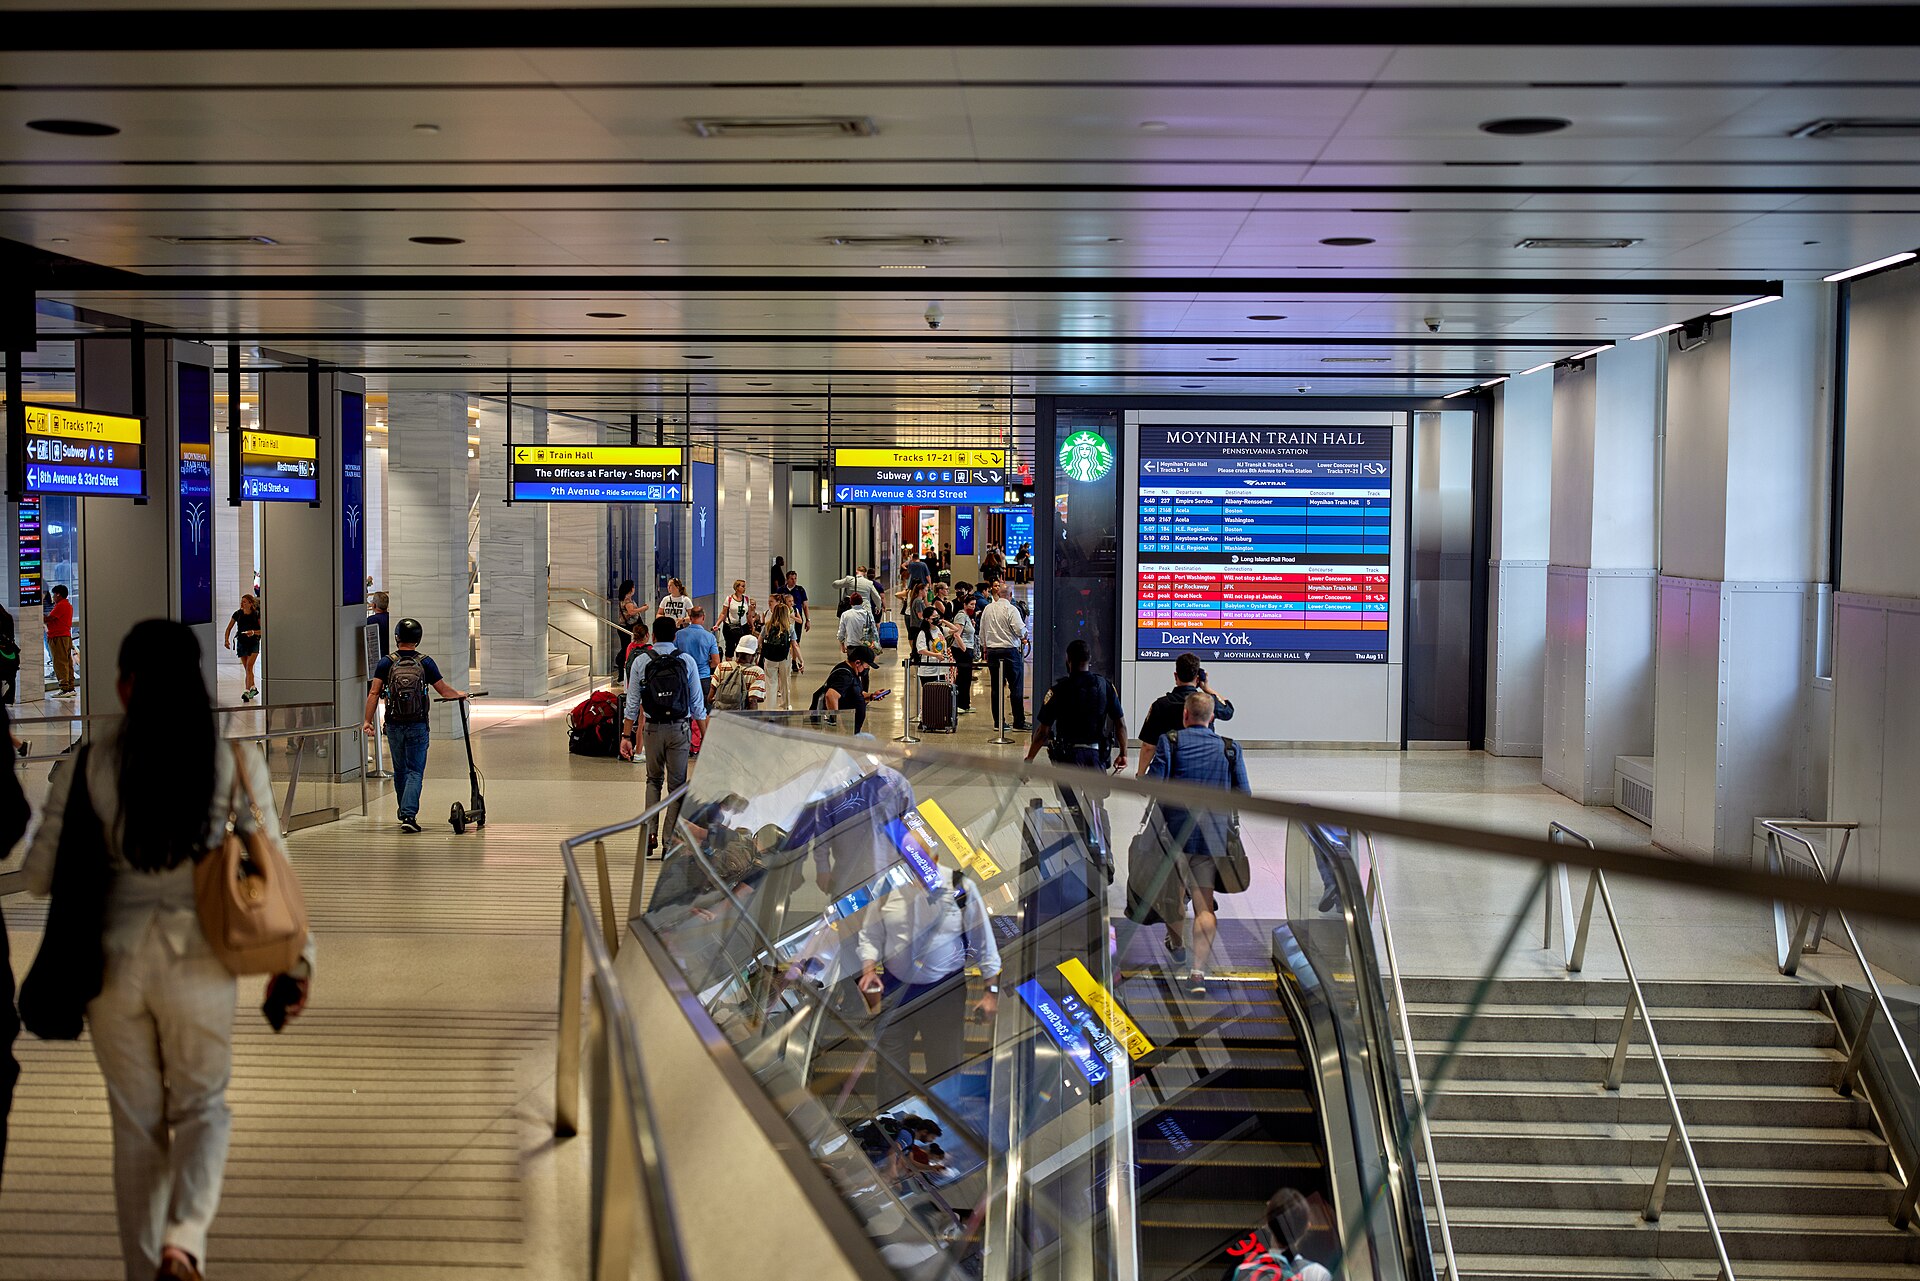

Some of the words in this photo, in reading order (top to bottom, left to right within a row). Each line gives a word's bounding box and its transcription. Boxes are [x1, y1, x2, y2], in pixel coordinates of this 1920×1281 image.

[62, 418, 84, 432] Tracks
[85, 421, 104, 434] 17-21
[258, 437, 270, 448] Train
[270, 438, 278, 449] Hall
[1166, 431, 1261, 444] MOYNIHAN
[1266, 432, 1318, 445] TRAIN
[1322, 432, 1365, 445] HALL
[62, 444, 88, 461] Subway
[550, 450, 573, 459] Train
[575, 451, 594, 459] Hall
[893, 453, 924, 462] Tracks
[927, 453, 953, 462] 17-21
[277, 462, 299, 473] Restrooms
[40, 471, 52, 484] 8th
[52, 472, 77, 485] Avenue
[78, 473, 84, 485] &
[84, 473, 98, 486] 33rd
[99, 474, 118, 487] Street
[535, 468, 552, 477] The
[554, 468, 585, 478] Offices
[586, 469, 596, 478] at
[599, 469, 627, 480] Farley
[634, 470, 662, 480] Shops
[876, 472, 912, 482] Subway
[258, 482, 268, 492] 31st
[268, 482, 282, 493] Street
[550, 486, 565, 496] 9th
[568, 487, 600, 496] Avenue
[854, 489, 869, 498] 8th
[871, 489, 904, 498] Avenue
[907, 490, 914, 498] &
[916, 489, 937, 498] 33rd
[939, 490, 967, 498] Street
[1161, 632, 1190, 644] Dear
[1192, 632, 1220, 644] New
[1222, 632, 1252, 646] York,
